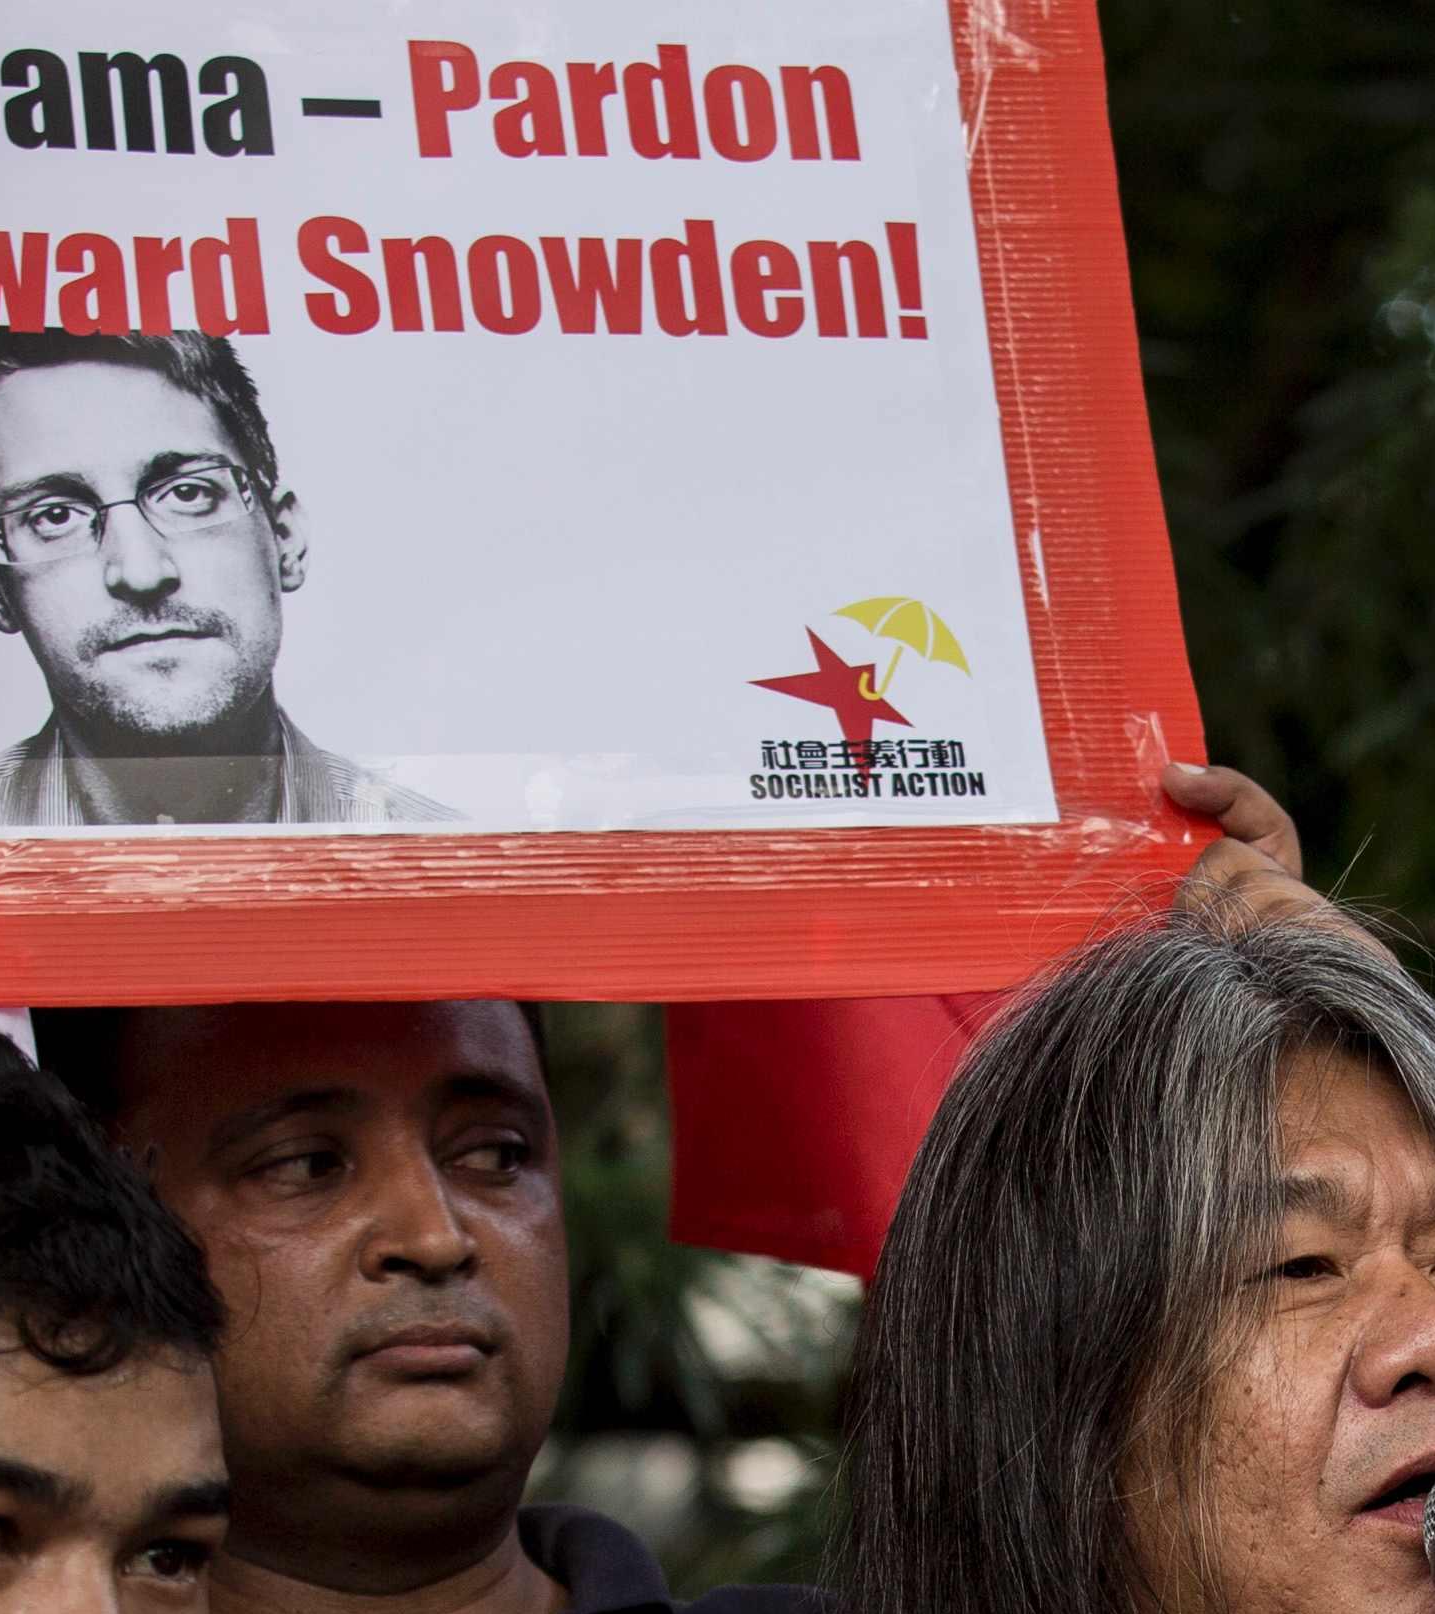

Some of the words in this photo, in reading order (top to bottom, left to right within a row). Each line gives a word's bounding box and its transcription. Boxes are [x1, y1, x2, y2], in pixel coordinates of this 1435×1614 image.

[407, 39, 862, 162] Pardon
[297, 214, 929, 340] Snowden!
[749, 773, 882, 800] SOCIALIST
[891, 772, 987, 797] ACTION
[761, 739, 966, 770] 社會主義行動
